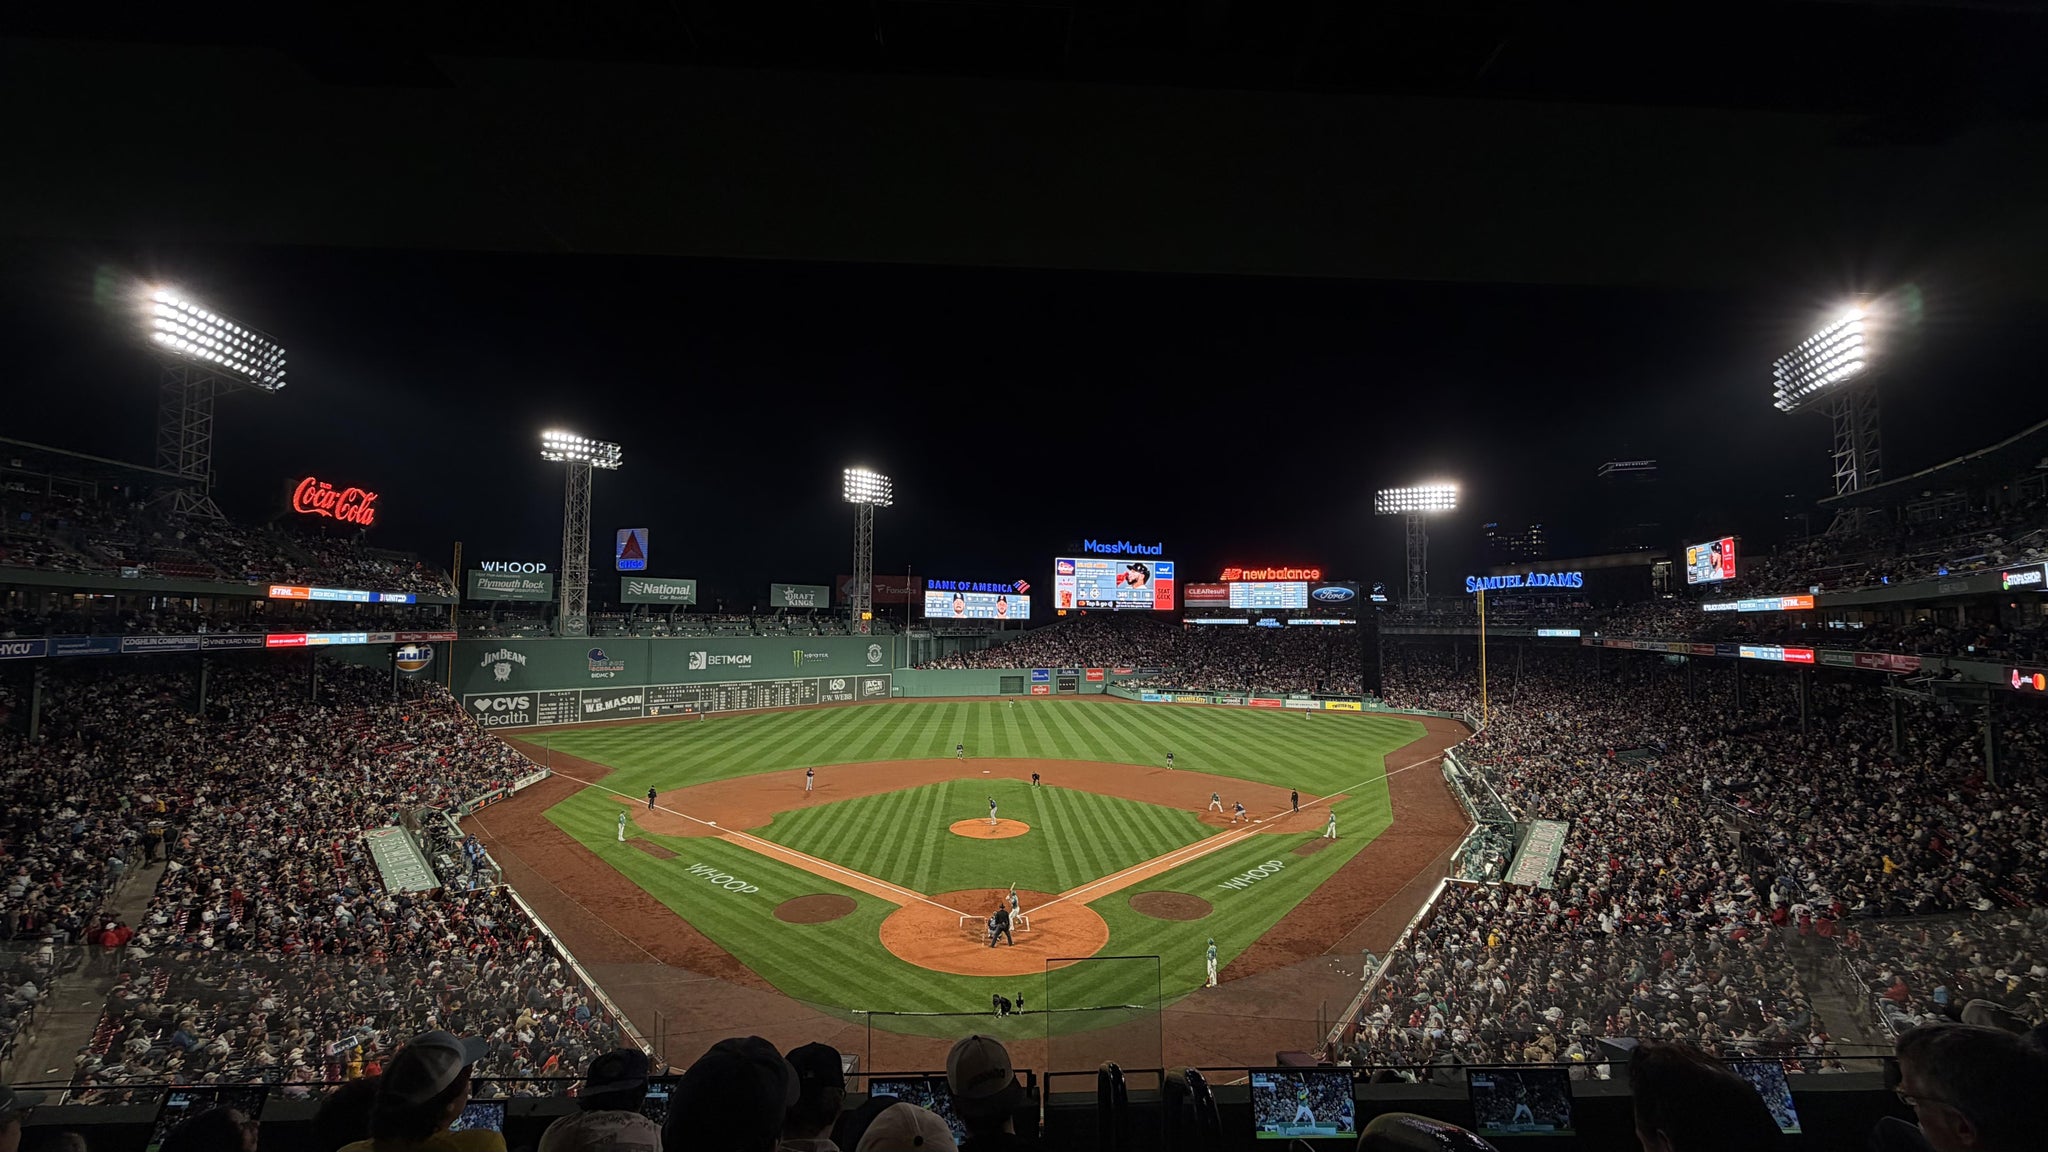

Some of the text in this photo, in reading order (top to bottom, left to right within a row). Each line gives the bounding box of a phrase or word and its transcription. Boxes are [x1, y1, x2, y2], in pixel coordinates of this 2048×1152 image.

[293, 476, 378, 525] Coca-Cola
[1084, 540, 1162, 555] MassMutual
[481, 561, 547, 574] WHOOP
[619, 561, 644, 569] CITGO
[478, 578, 544, 589] Plymouth Rock
[928, 580, 1013, 593] BANK OF AMERICA
[1466, 571, 1584, 592] SAMUEL ADAMS
[643, 584, 691, 595] National
[1319, 589, 1346, 600] Ford
[785, 593, 815, 601] DRAFT
[158, 637, 198, 645] COMPANIES
[397, 649, 431, 660] Gulf
[481, 648, 527, 668] JIM BEAM
[708, 655, 752, 665] BETMGM
[493, 696, 530, 711] CVS
[476, 711, 530, 726] Health
[684, 862, 760, 894] WHOOP
[1218, 860, 1286, 890] WHOOP
